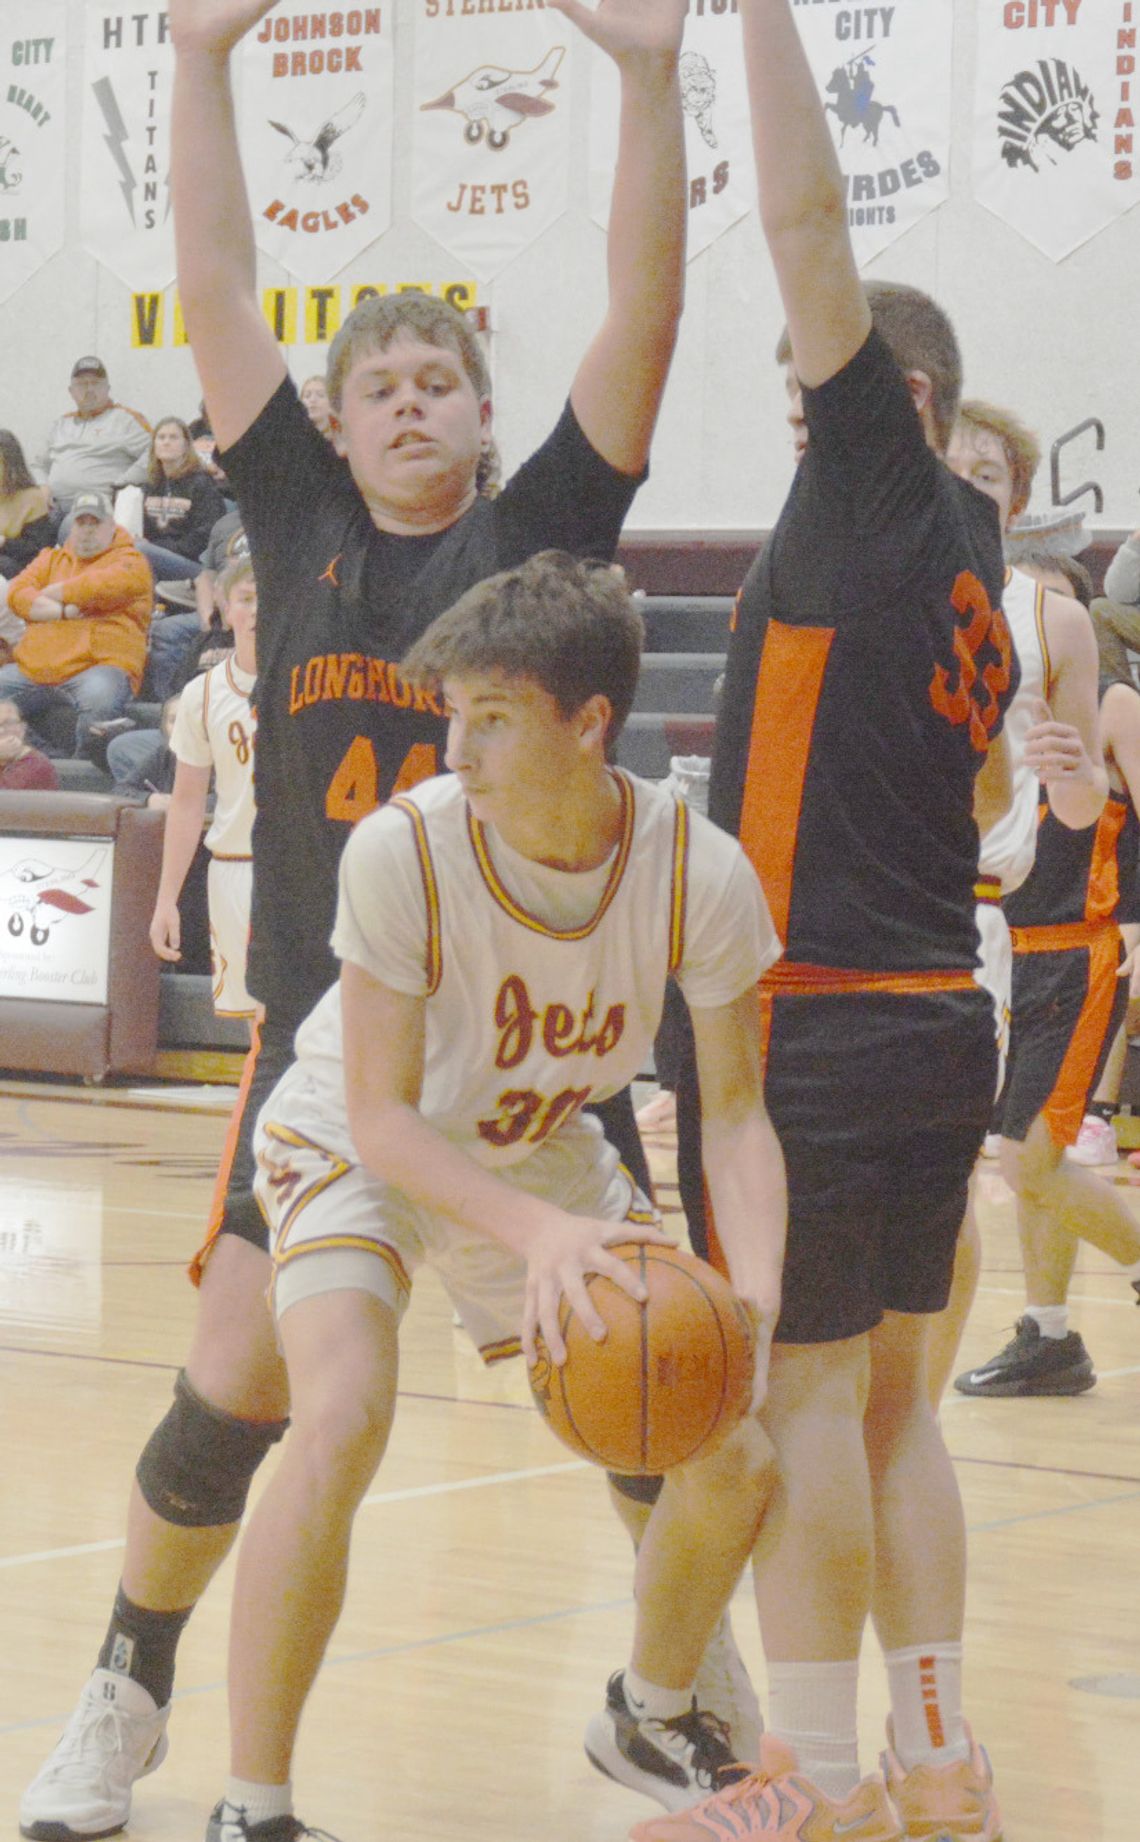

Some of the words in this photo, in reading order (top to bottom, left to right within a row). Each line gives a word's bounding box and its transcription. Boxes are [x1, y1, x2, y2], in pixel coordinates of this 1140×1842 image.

[257, 8, 382, 44] JOHNSON
[835, 7, 895, 41] CITY
[1003, 0, 1081, 29] CITY
[12, 38, 55, 66] CITY
[272, 46, 363, 78] BROCK
[1114, 2, 1136, 181] INDIANS
[144, 70, 158, 230] TITANS
[262, 193, 370, 234] EAGLES
[447, 179, 531, 216] JETS
[70, 967, 98, 985] Club
